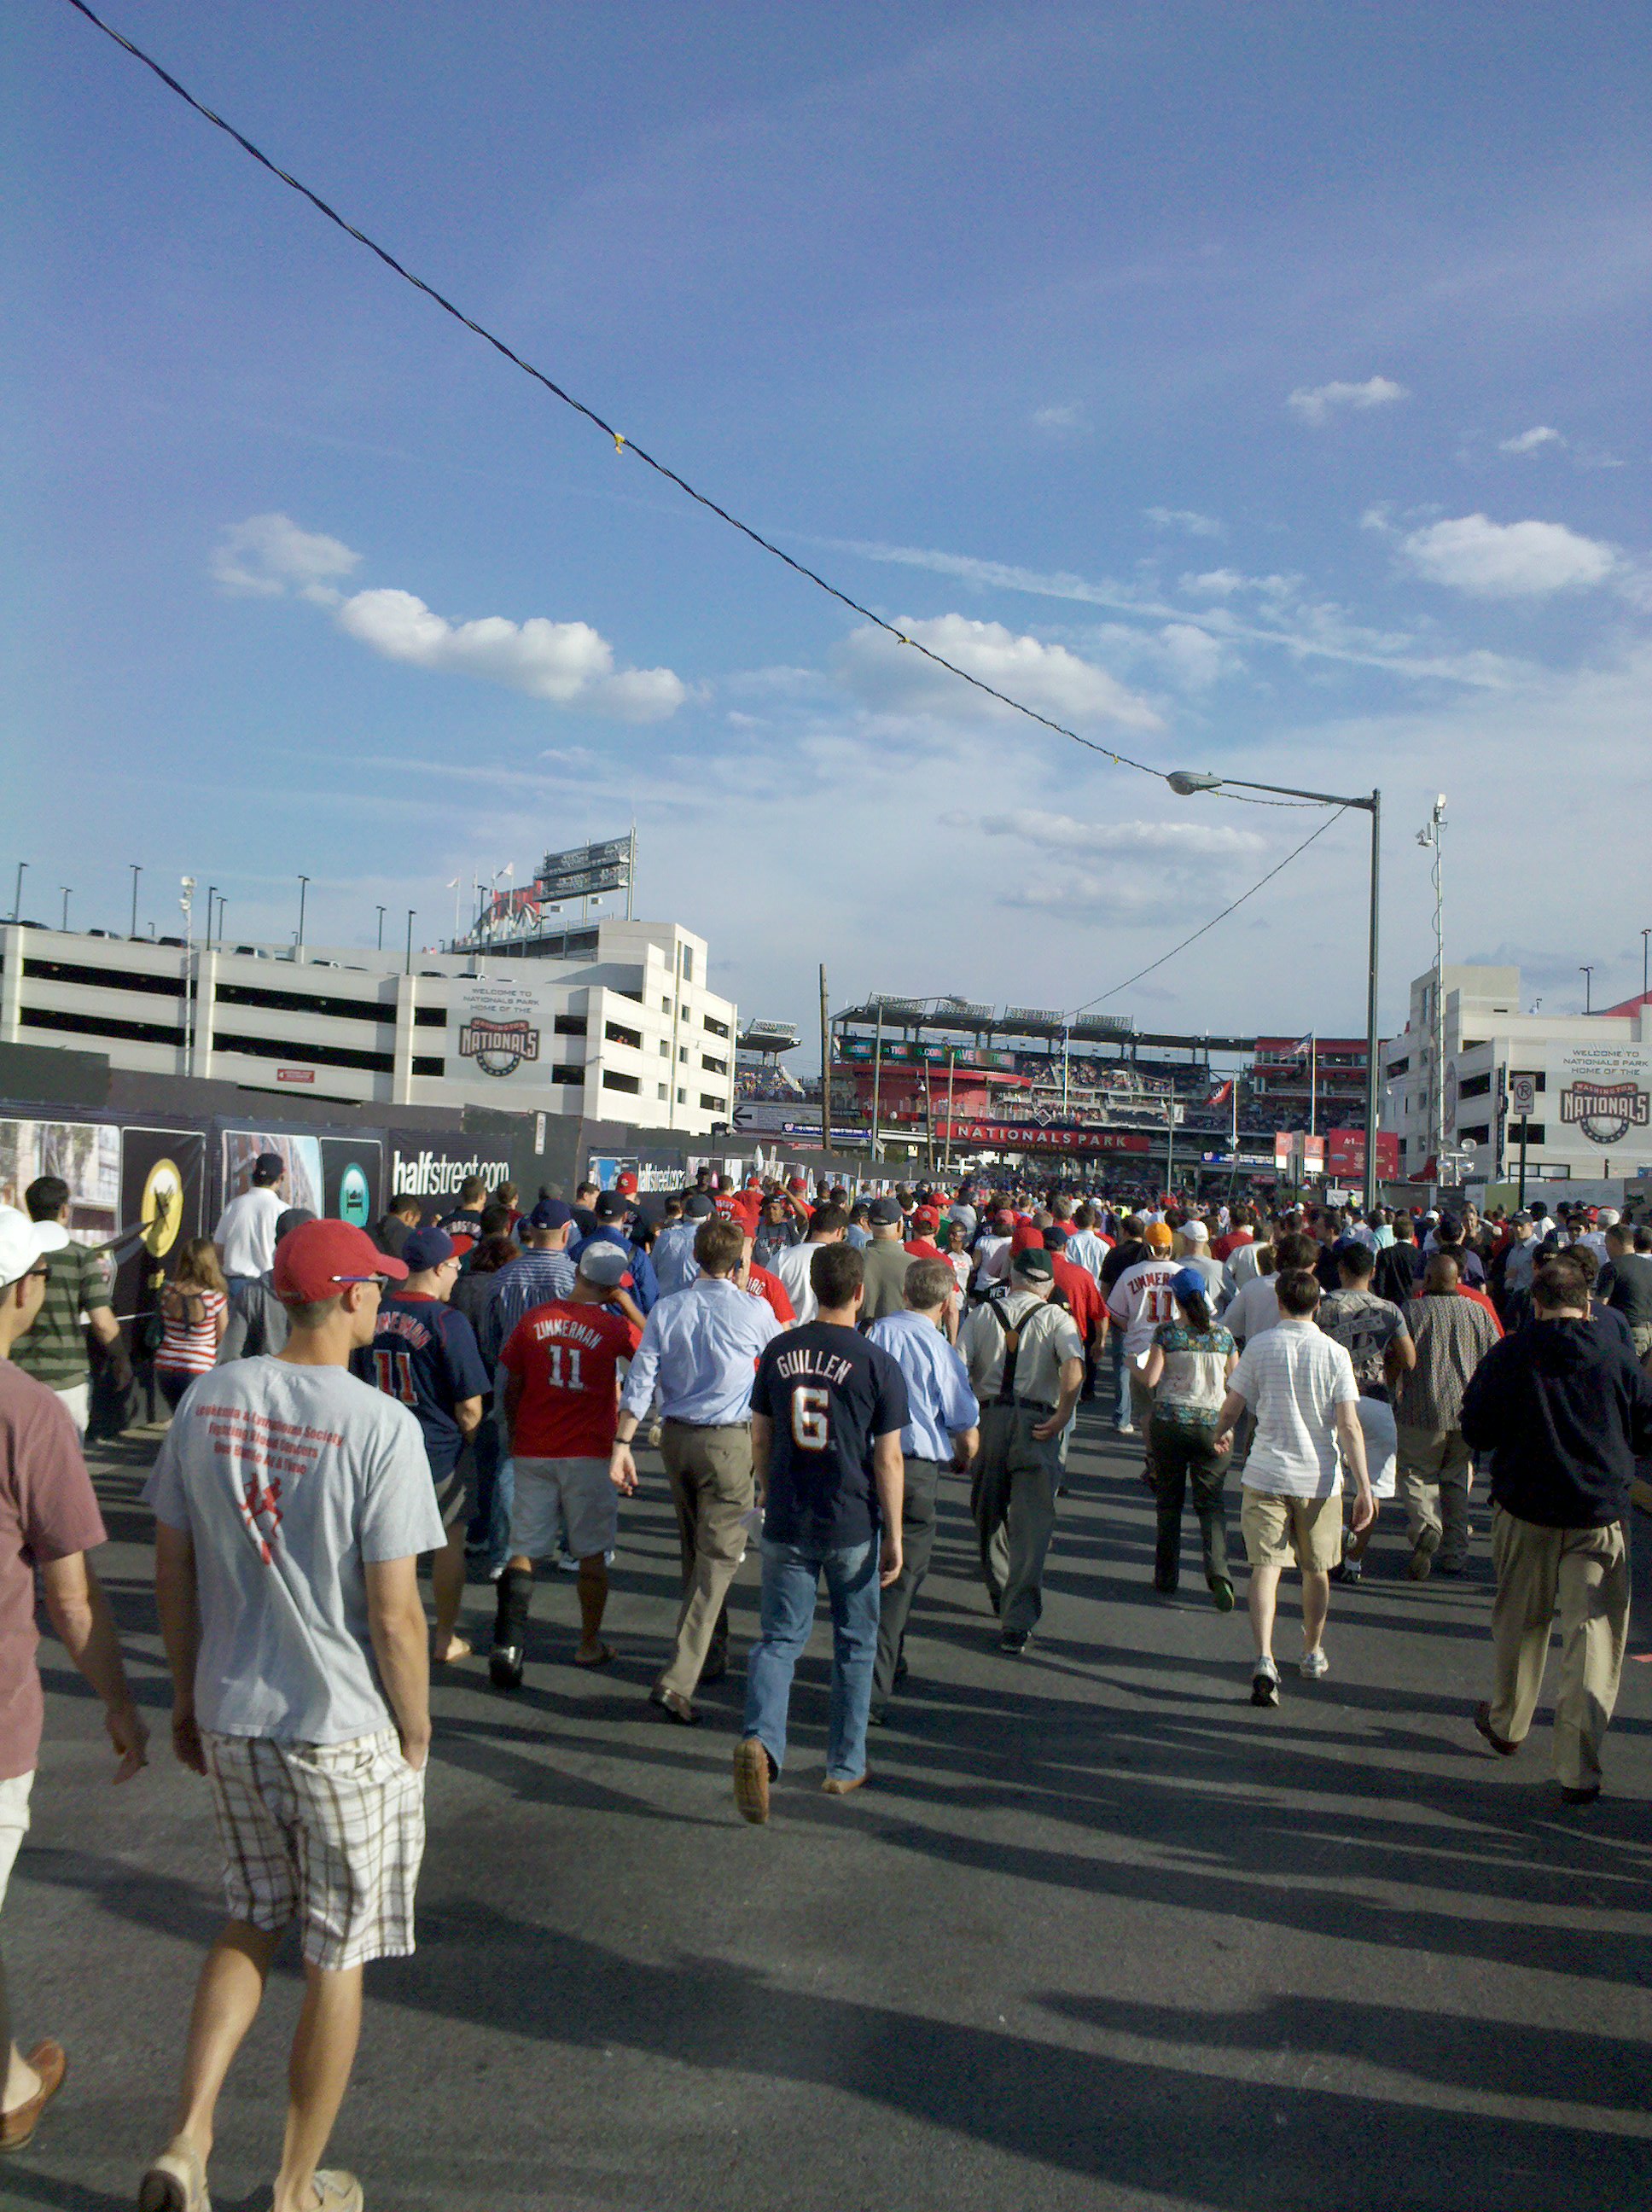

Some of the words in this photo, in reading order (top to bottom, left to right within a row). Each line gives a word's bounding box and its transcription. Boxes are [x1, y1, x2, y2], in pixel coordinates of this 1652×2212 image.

[463, 996, 514, 1004] NATIONALS
[472, 988, 517, 997] WELCOME
[461, 1027, 538, 1059] NATIONALS
[1573, 1050, 1622, 1058] WELCOME
[1574, 1083, 1635, 1096] WASHINGTON
[1561, 1091, 1649, 1125] NATIONALS
[957, 1125, 1072, 1144] NATIONALS
[1078, 1133, 1127, 1148] PARK
[1126, 1272, 1176, 1295] ZIMMER
[1146, 1290, 1172, 1324] 11
[532, 1318, 603, 1350] ZIMMERMAN
[373, 1349, 420, 1407] 11
[548, 1344, 585, 1390] 11
[777, 1349, 852, 1384] GUILLEN
[792, 1385, 829, 1452] 6
[305, 1425, 345, 1448] Society
